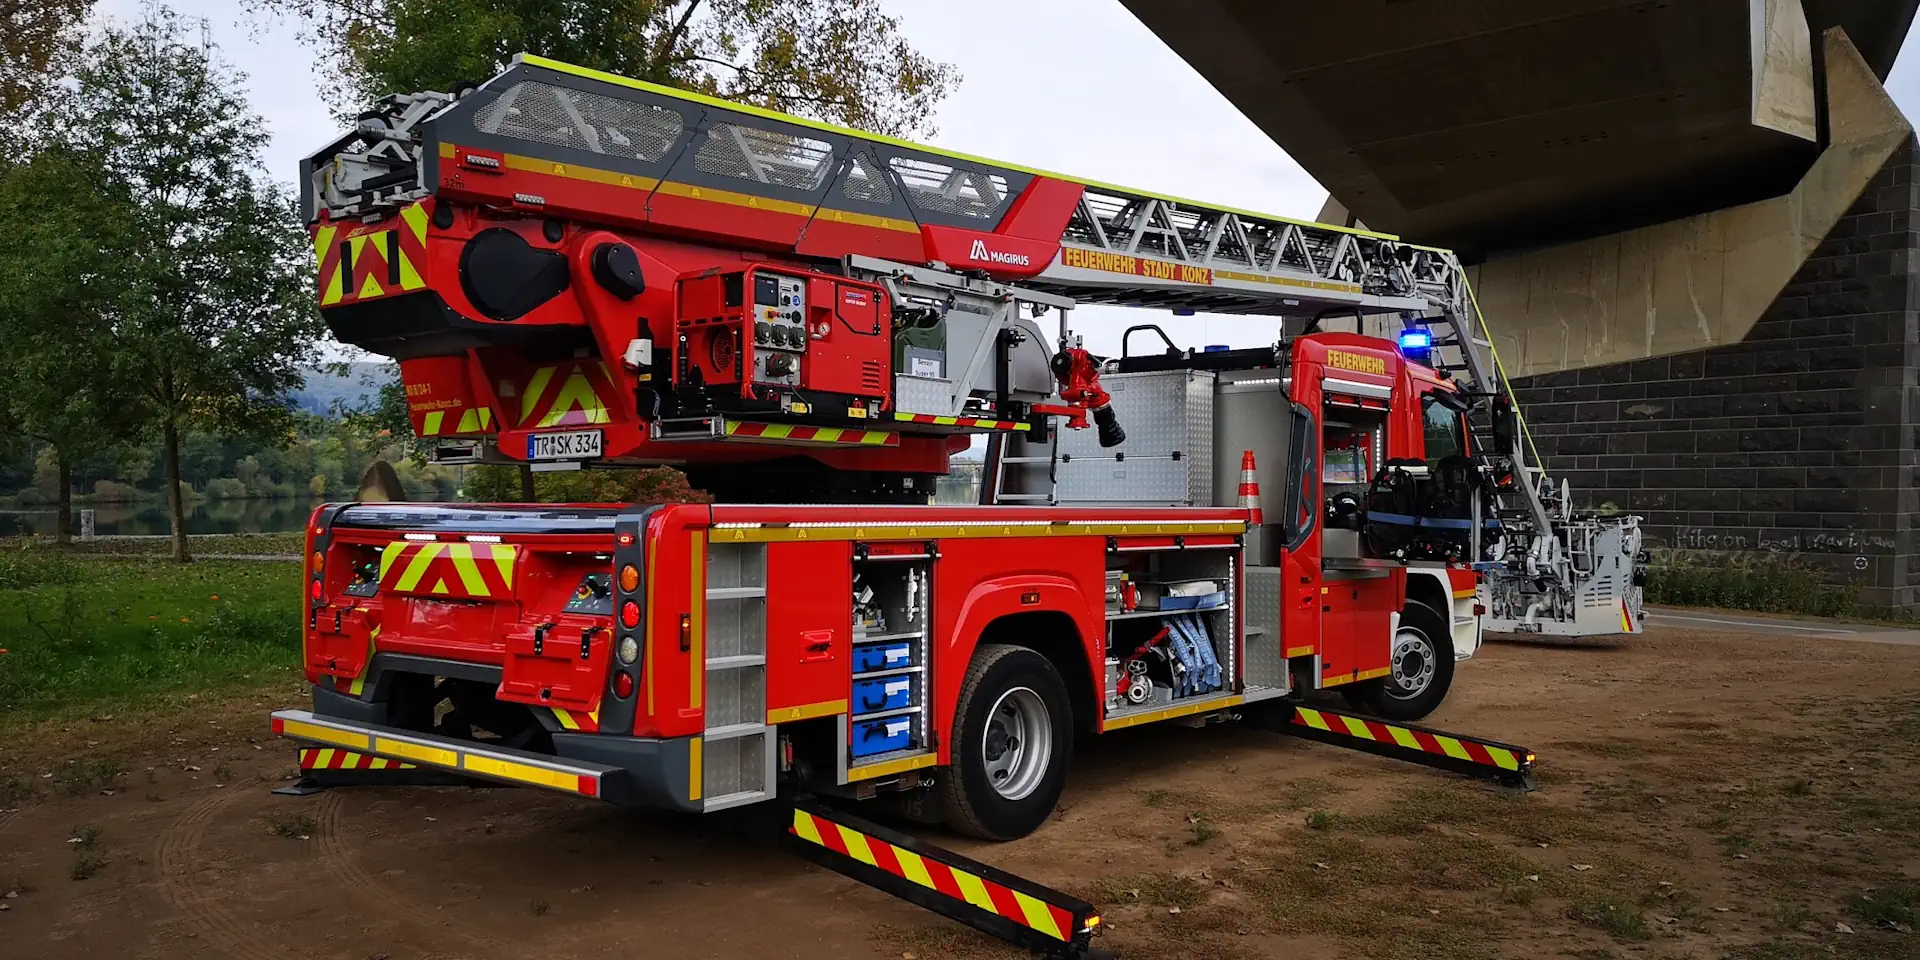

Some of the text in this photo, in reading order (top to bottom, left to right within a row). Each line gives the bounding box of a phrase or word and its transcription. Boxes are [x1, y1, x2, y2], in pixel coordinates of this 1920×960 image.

[444, 177, 465, 189] 32m
[990, 250, 1029, 266] MAGIRUS
[1065, 247, 1209, 284] FEUERWEHR STADT KONZ
[1327, 349, 1385, 375] FEUERWEHR
[534, 433, 599, 456] TR SK 334
[1724, 535, 1748, 549] on
